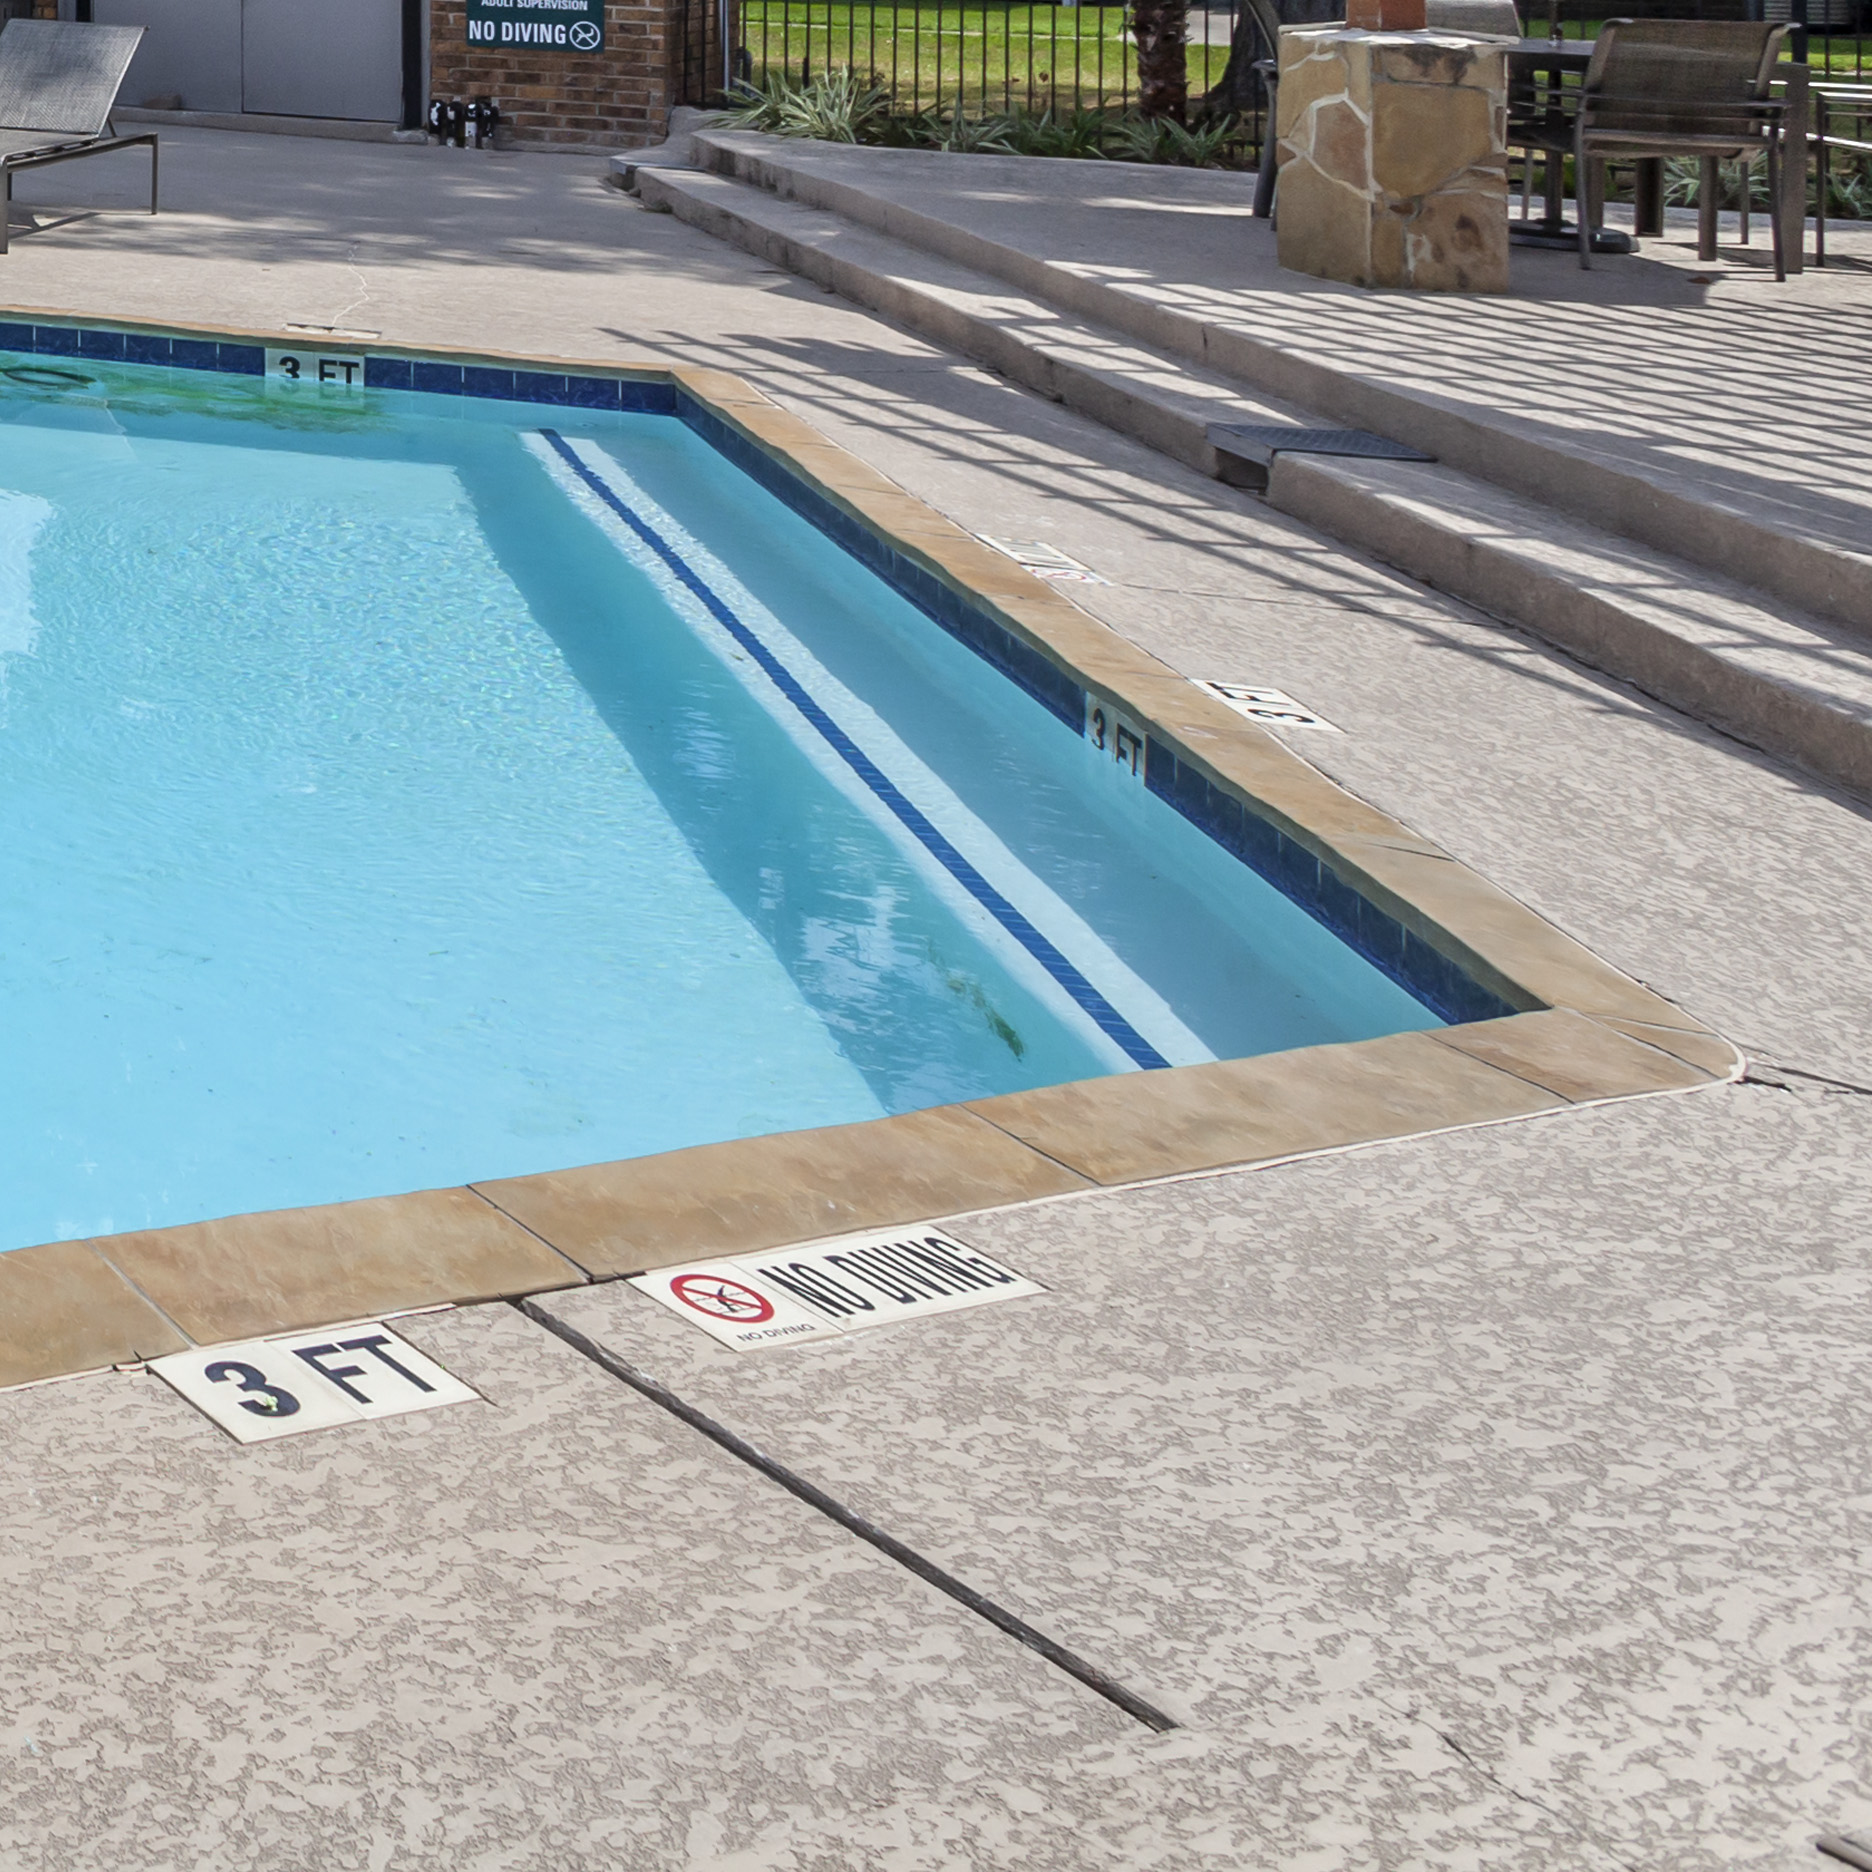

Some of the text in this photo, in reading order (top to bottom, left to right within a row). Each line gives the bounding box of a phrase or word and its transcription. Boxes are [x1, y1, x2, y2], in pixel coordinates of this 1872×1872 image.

[469, 20, 566, 44] NO DIVING
[279, 356, 360, 384] 3 FT
[1205, 681, 1316, 724] 3 FT
[1091, 707, 1142, 777] 3 FT
[758, 1236, 1018, 1319] NO DIVING
[736, 1321, 817, 1343] NO DIVING
[204, 1334, 438, 1418] 3 FT
